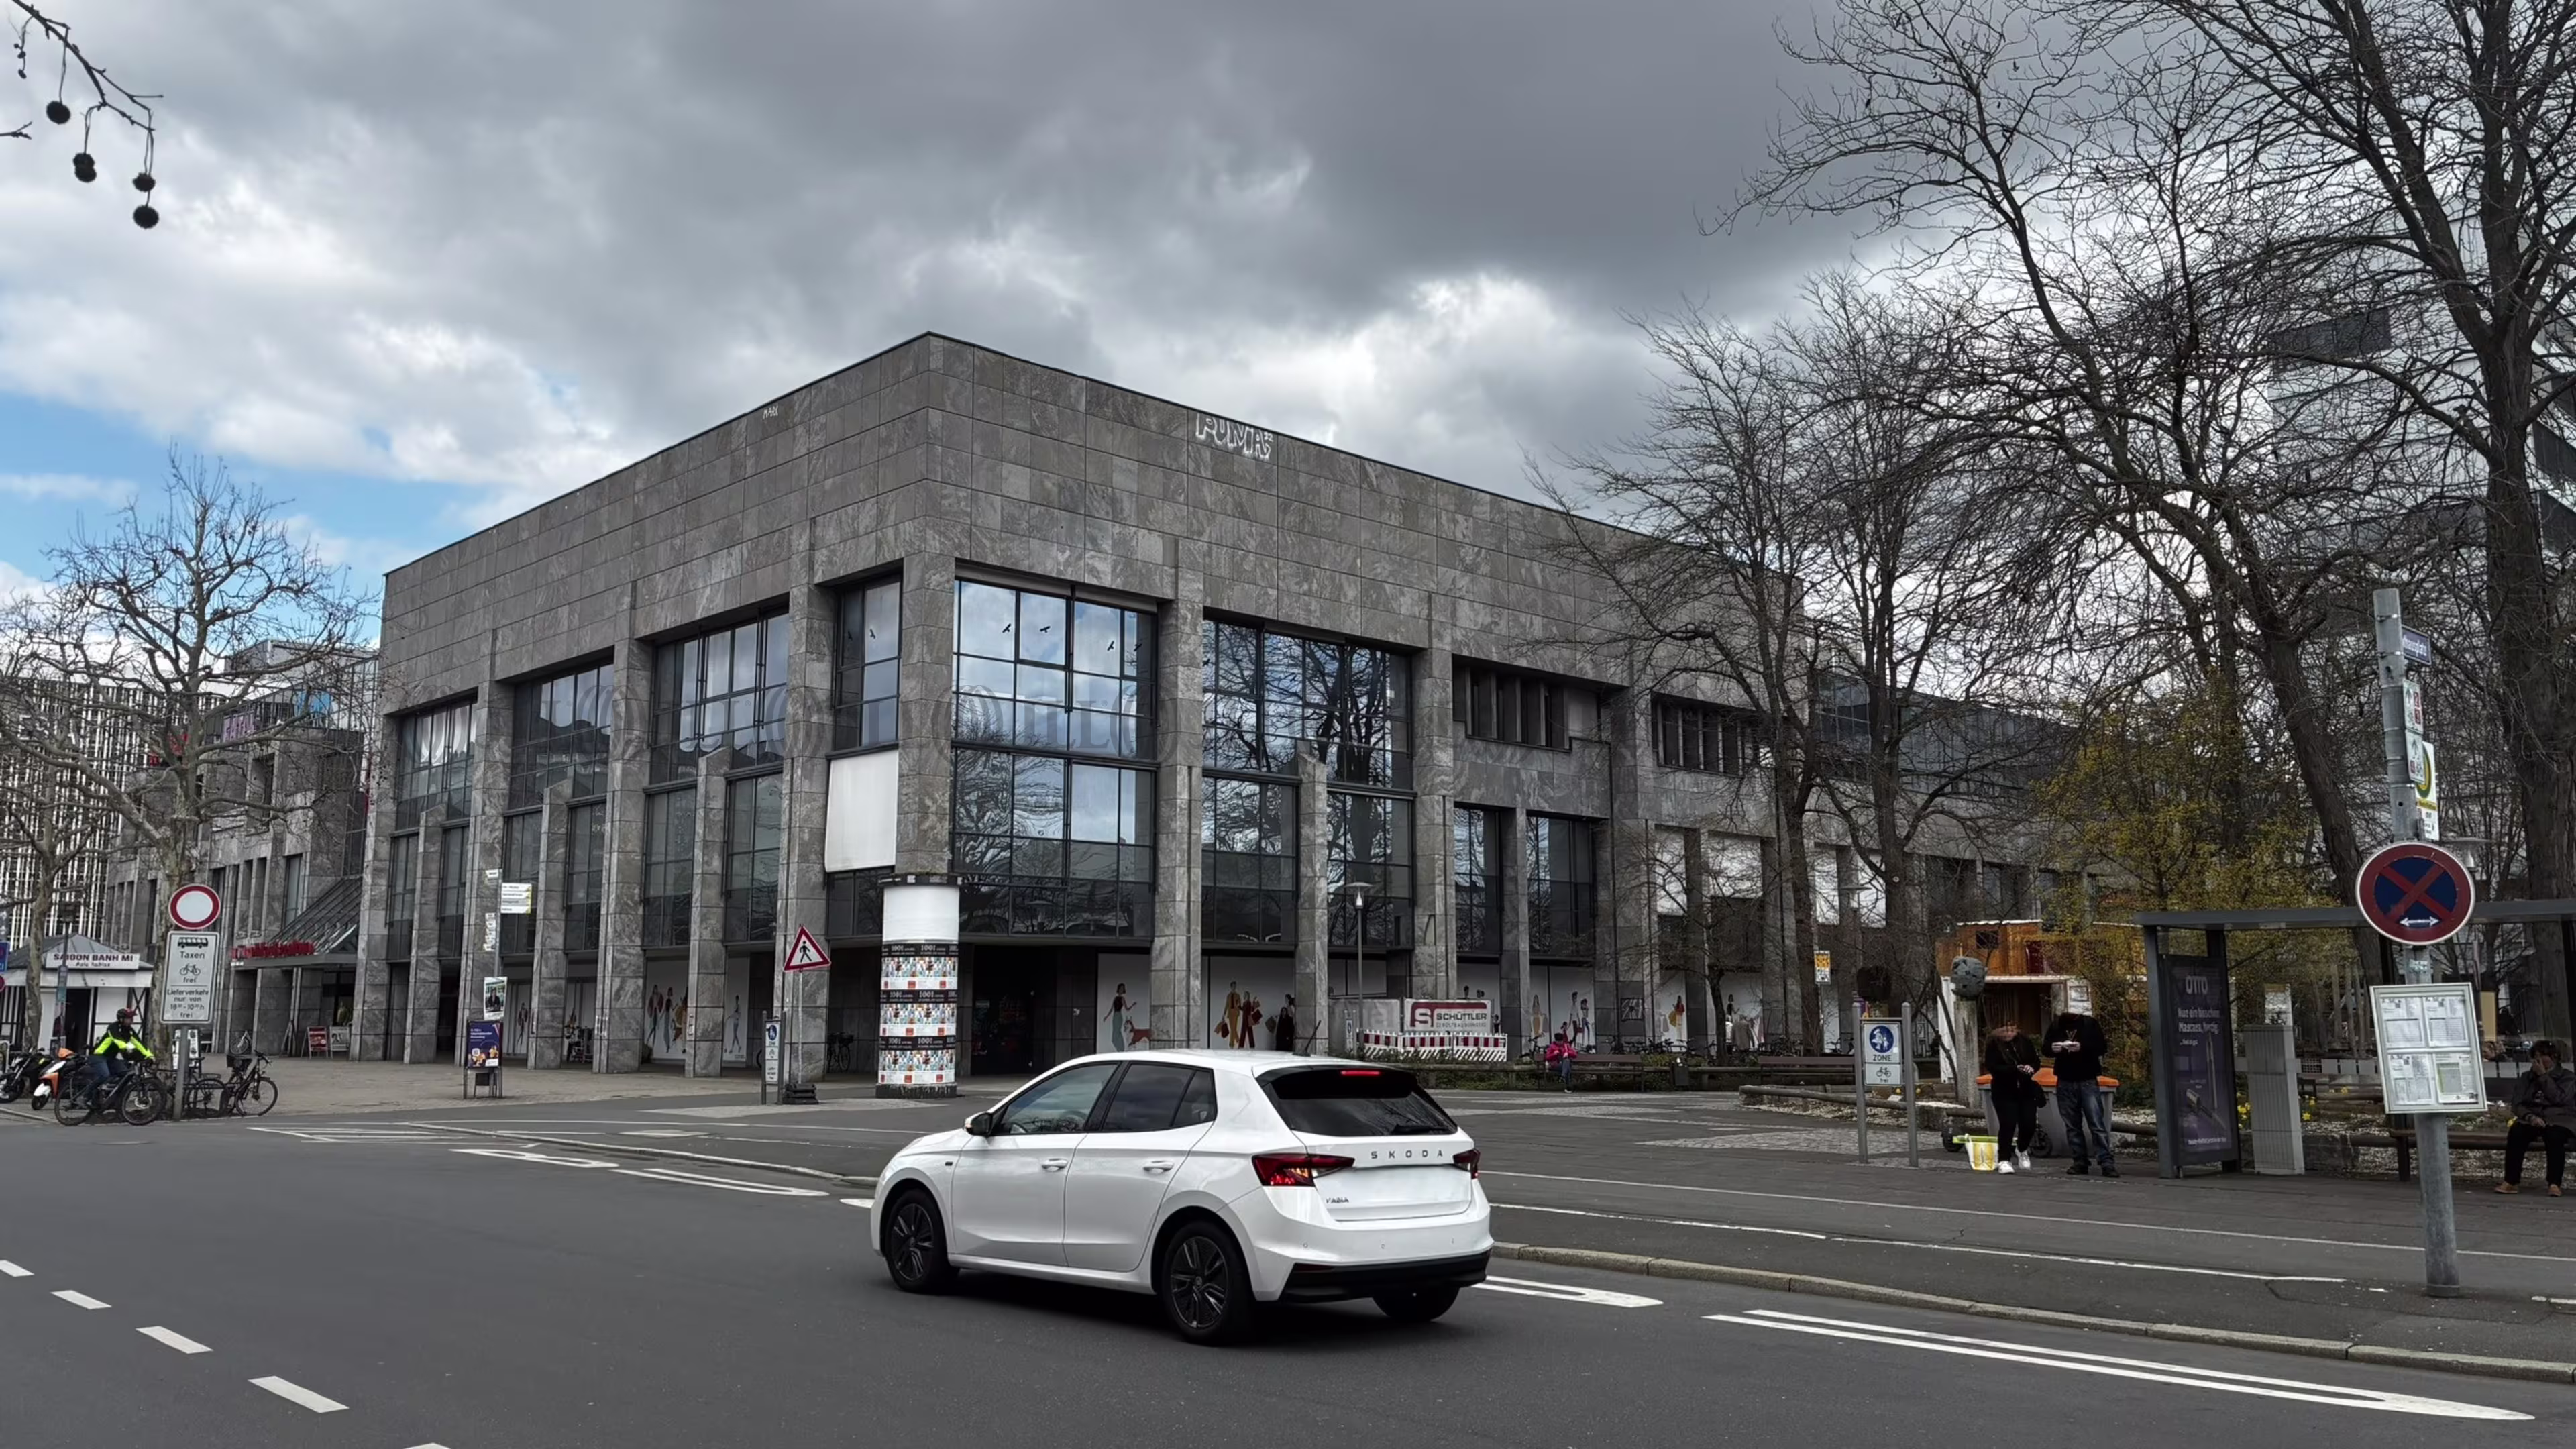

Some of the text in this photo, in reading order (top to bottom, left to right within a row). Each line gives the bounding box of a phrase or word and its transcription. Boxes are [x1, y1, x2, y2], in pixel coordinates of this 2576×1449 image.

[180, 951, 205, 959] Taxen
[2186, 975, 2208, 994] OTTO
[1436, 1011, 1487, 1020] SCHÜTTLER
